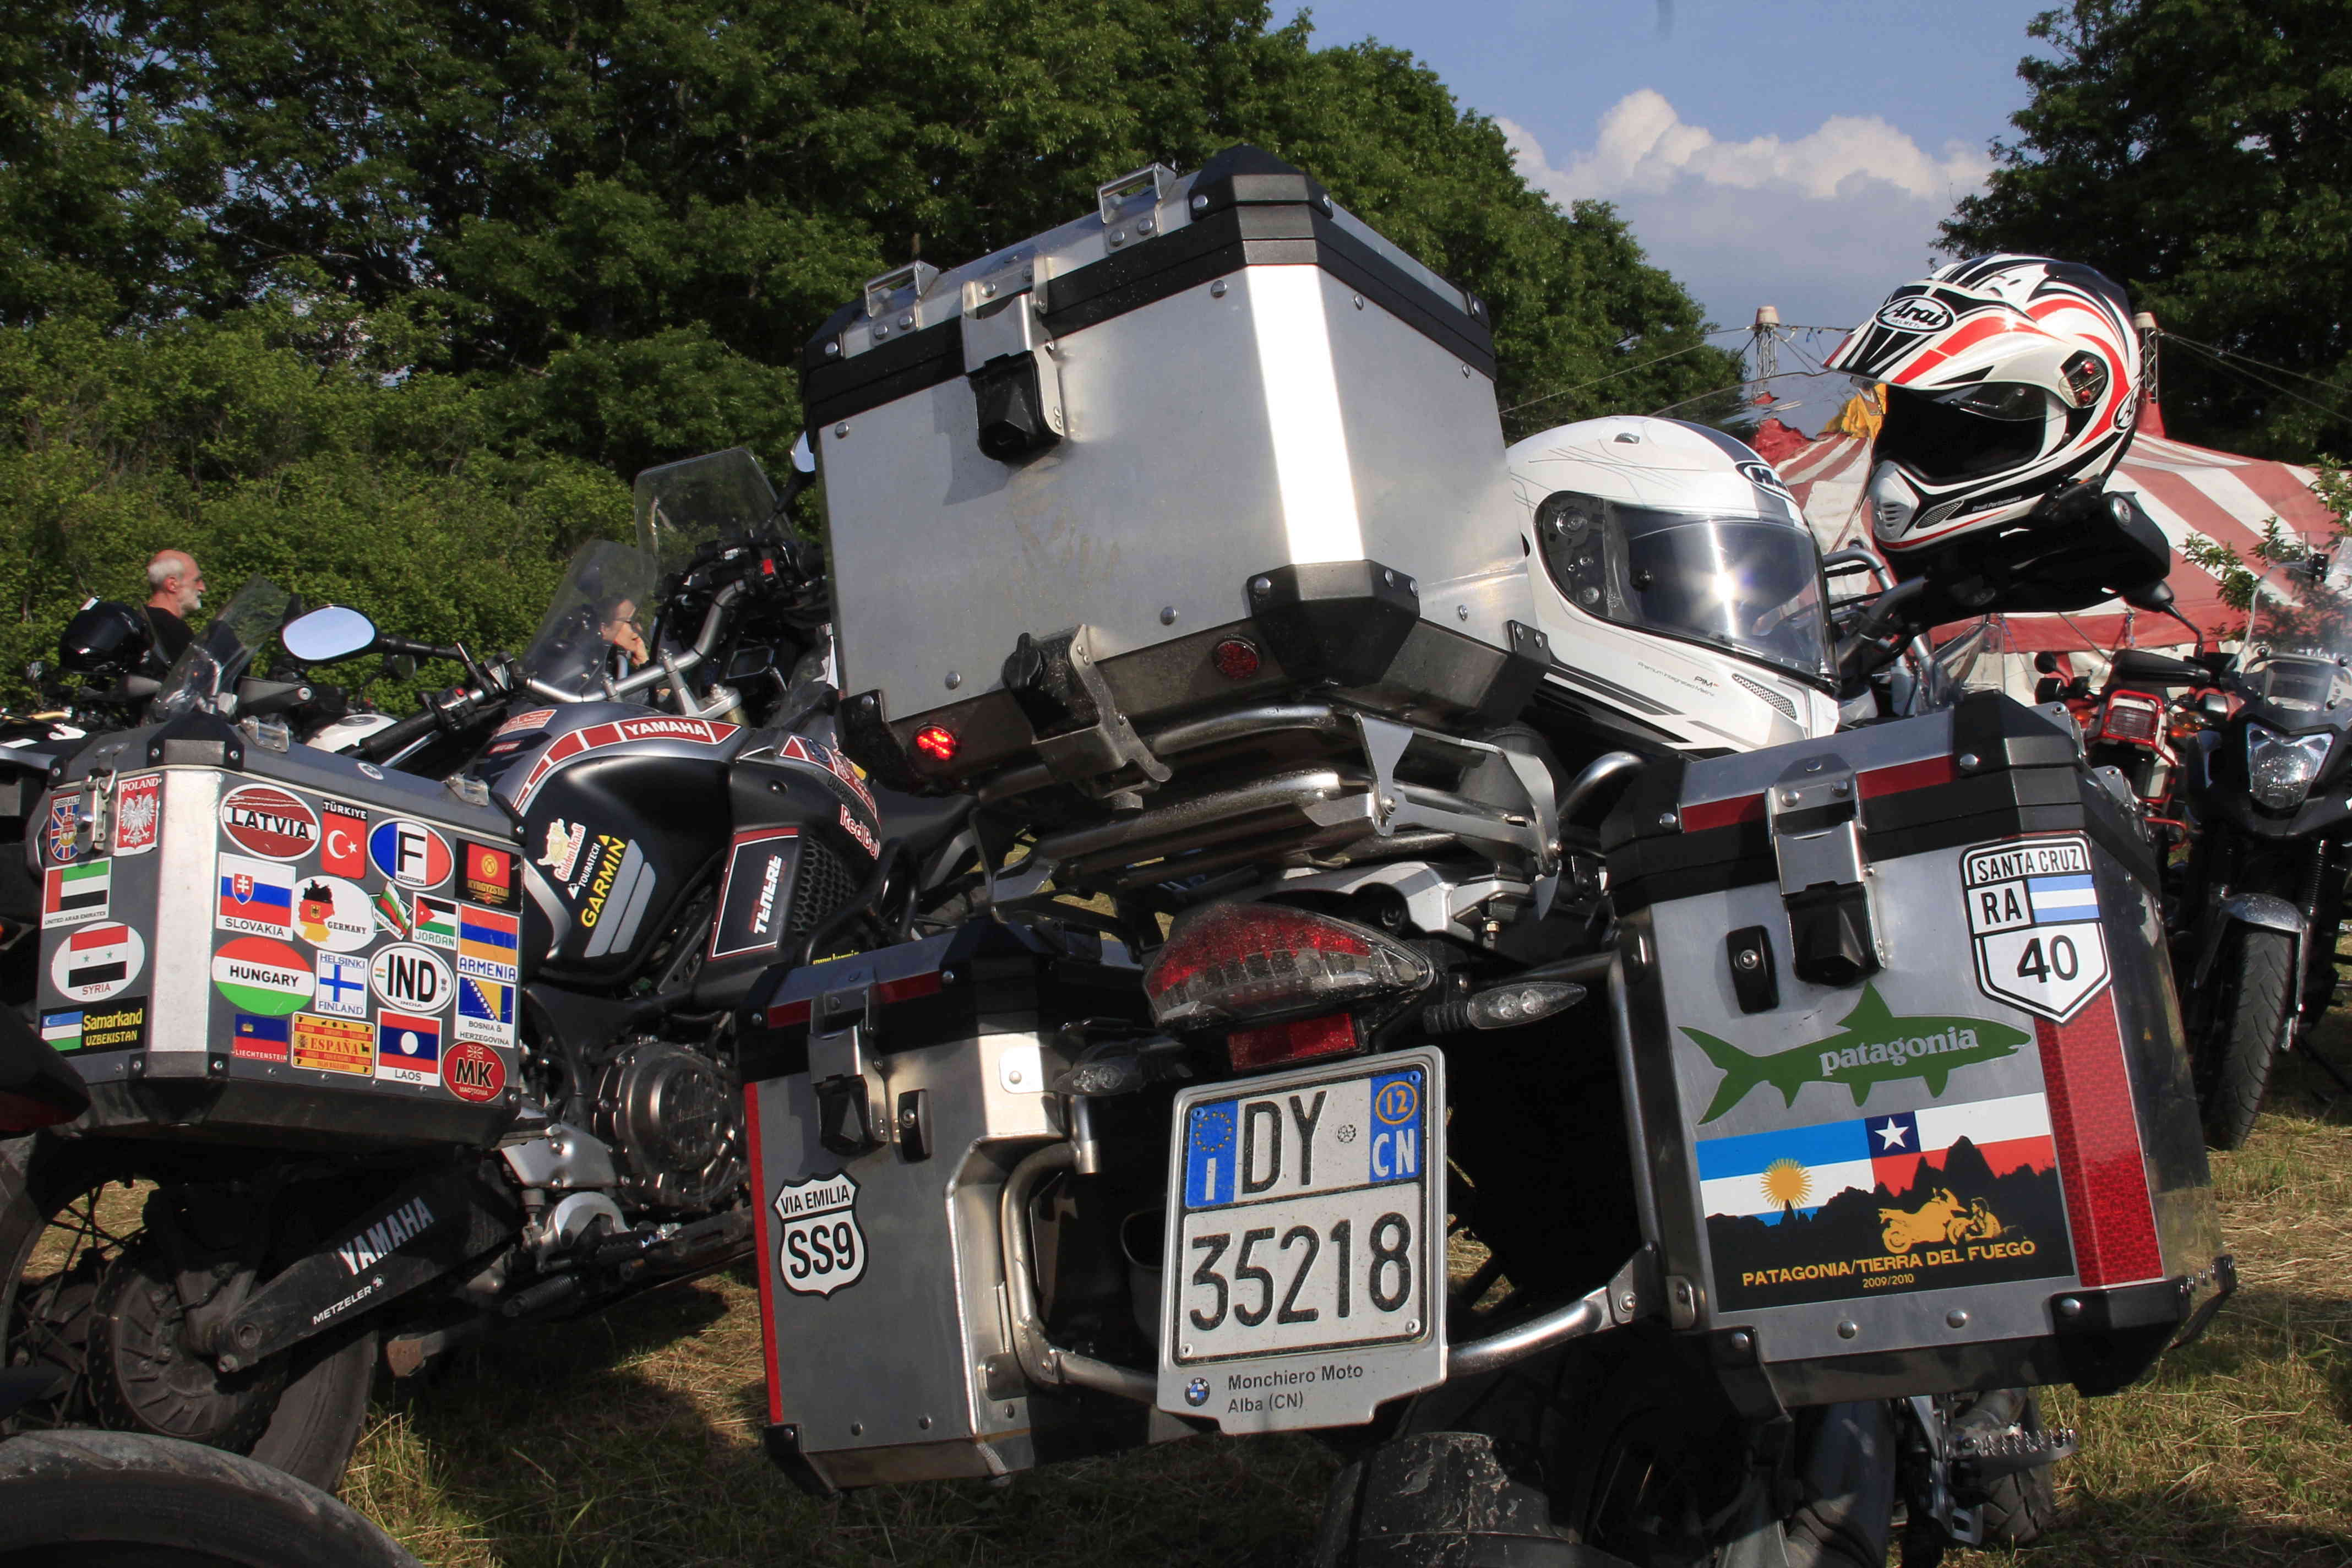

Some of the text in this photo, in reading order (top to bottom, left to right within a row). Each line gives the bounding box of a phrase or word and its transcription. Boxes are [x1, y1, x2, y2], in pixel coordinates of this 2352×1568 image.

[1880, 300, 1948, 325] Arai
[624, 721, 709, 737] YAMAHA
[122, 778, 159, 792] POLAND
[55, 796, 80, 807] GIBRALT
[231, 808, 310, 840] LATVIA
[568, 824, 584, 851] Draak
[398, 831, 426, 872] F
[1977, 847, 2081, 881] SANTA CRUZ
[579, 843, 602, 887] TOURATECH
[581, 837, 626, 928] GARMIN
[80, 911, 106, 919] EMIRATES
[1983, 887, 2022, 925] RA
[225, 918, 285, 937] SLOVAKIA
[327, 921, 367, 935] GERMANY
[415, 931, 455, 948] JORDAN
[320, 953, 366, 968] HELSINKI
[459, 957, 516, 980] ARMENIA
[2017, 934, 2079, 984] 40
[83, 983, 111, 995] SYRIA
[230, 965, 300, 988] HUNGARY
[388, 954, 437, 1003] IND
[83, 1008, 143, 1031] Samarkand
[318, 1000, 364, 1015] FINLAND
[85, 1030, 138, 1047] UZBEKISTAN
[460, 1031, 509, 1046] HERZEGOVINA
[468, 1021, 502, 1032] BOSNIA &
[236, 1049, 287, 1060] LIECHTENSTEIN
[311, 1038, 359, 1055] ESPAÑA
[1819, 1026, 1979, 1076] patagonia
[395, 1070, 422, 1081] LAOS
[454, 1058, 495, 1088] MK
[1386, 1090, 1408, 1115] 12
[1242, 1091, 1327, 1194] DY
[1373, 1129, 1415, 1178] CN
[1205, 1157, 1216, 1200] I
[781, 1184, 851, 1214] VIA EMILIA
[338, 1196, 435, 1276] YAMAHA
[788, 1221, 856, 1279] SS9
[1928, 1247, 1965, 1266] DEL
[1967, 1240, 2036, 1261] FUEGO
[1190, 1212, 1412, 1331] 35218
[1862, 1273, 1915, 1289] 2009/2010
[313, 1285, 373, 1325] METZELER
[1228, 1364, 1363, 1391] Monchiero Moto
[1228, 1393, 1304, 1413] Alba (CN)
